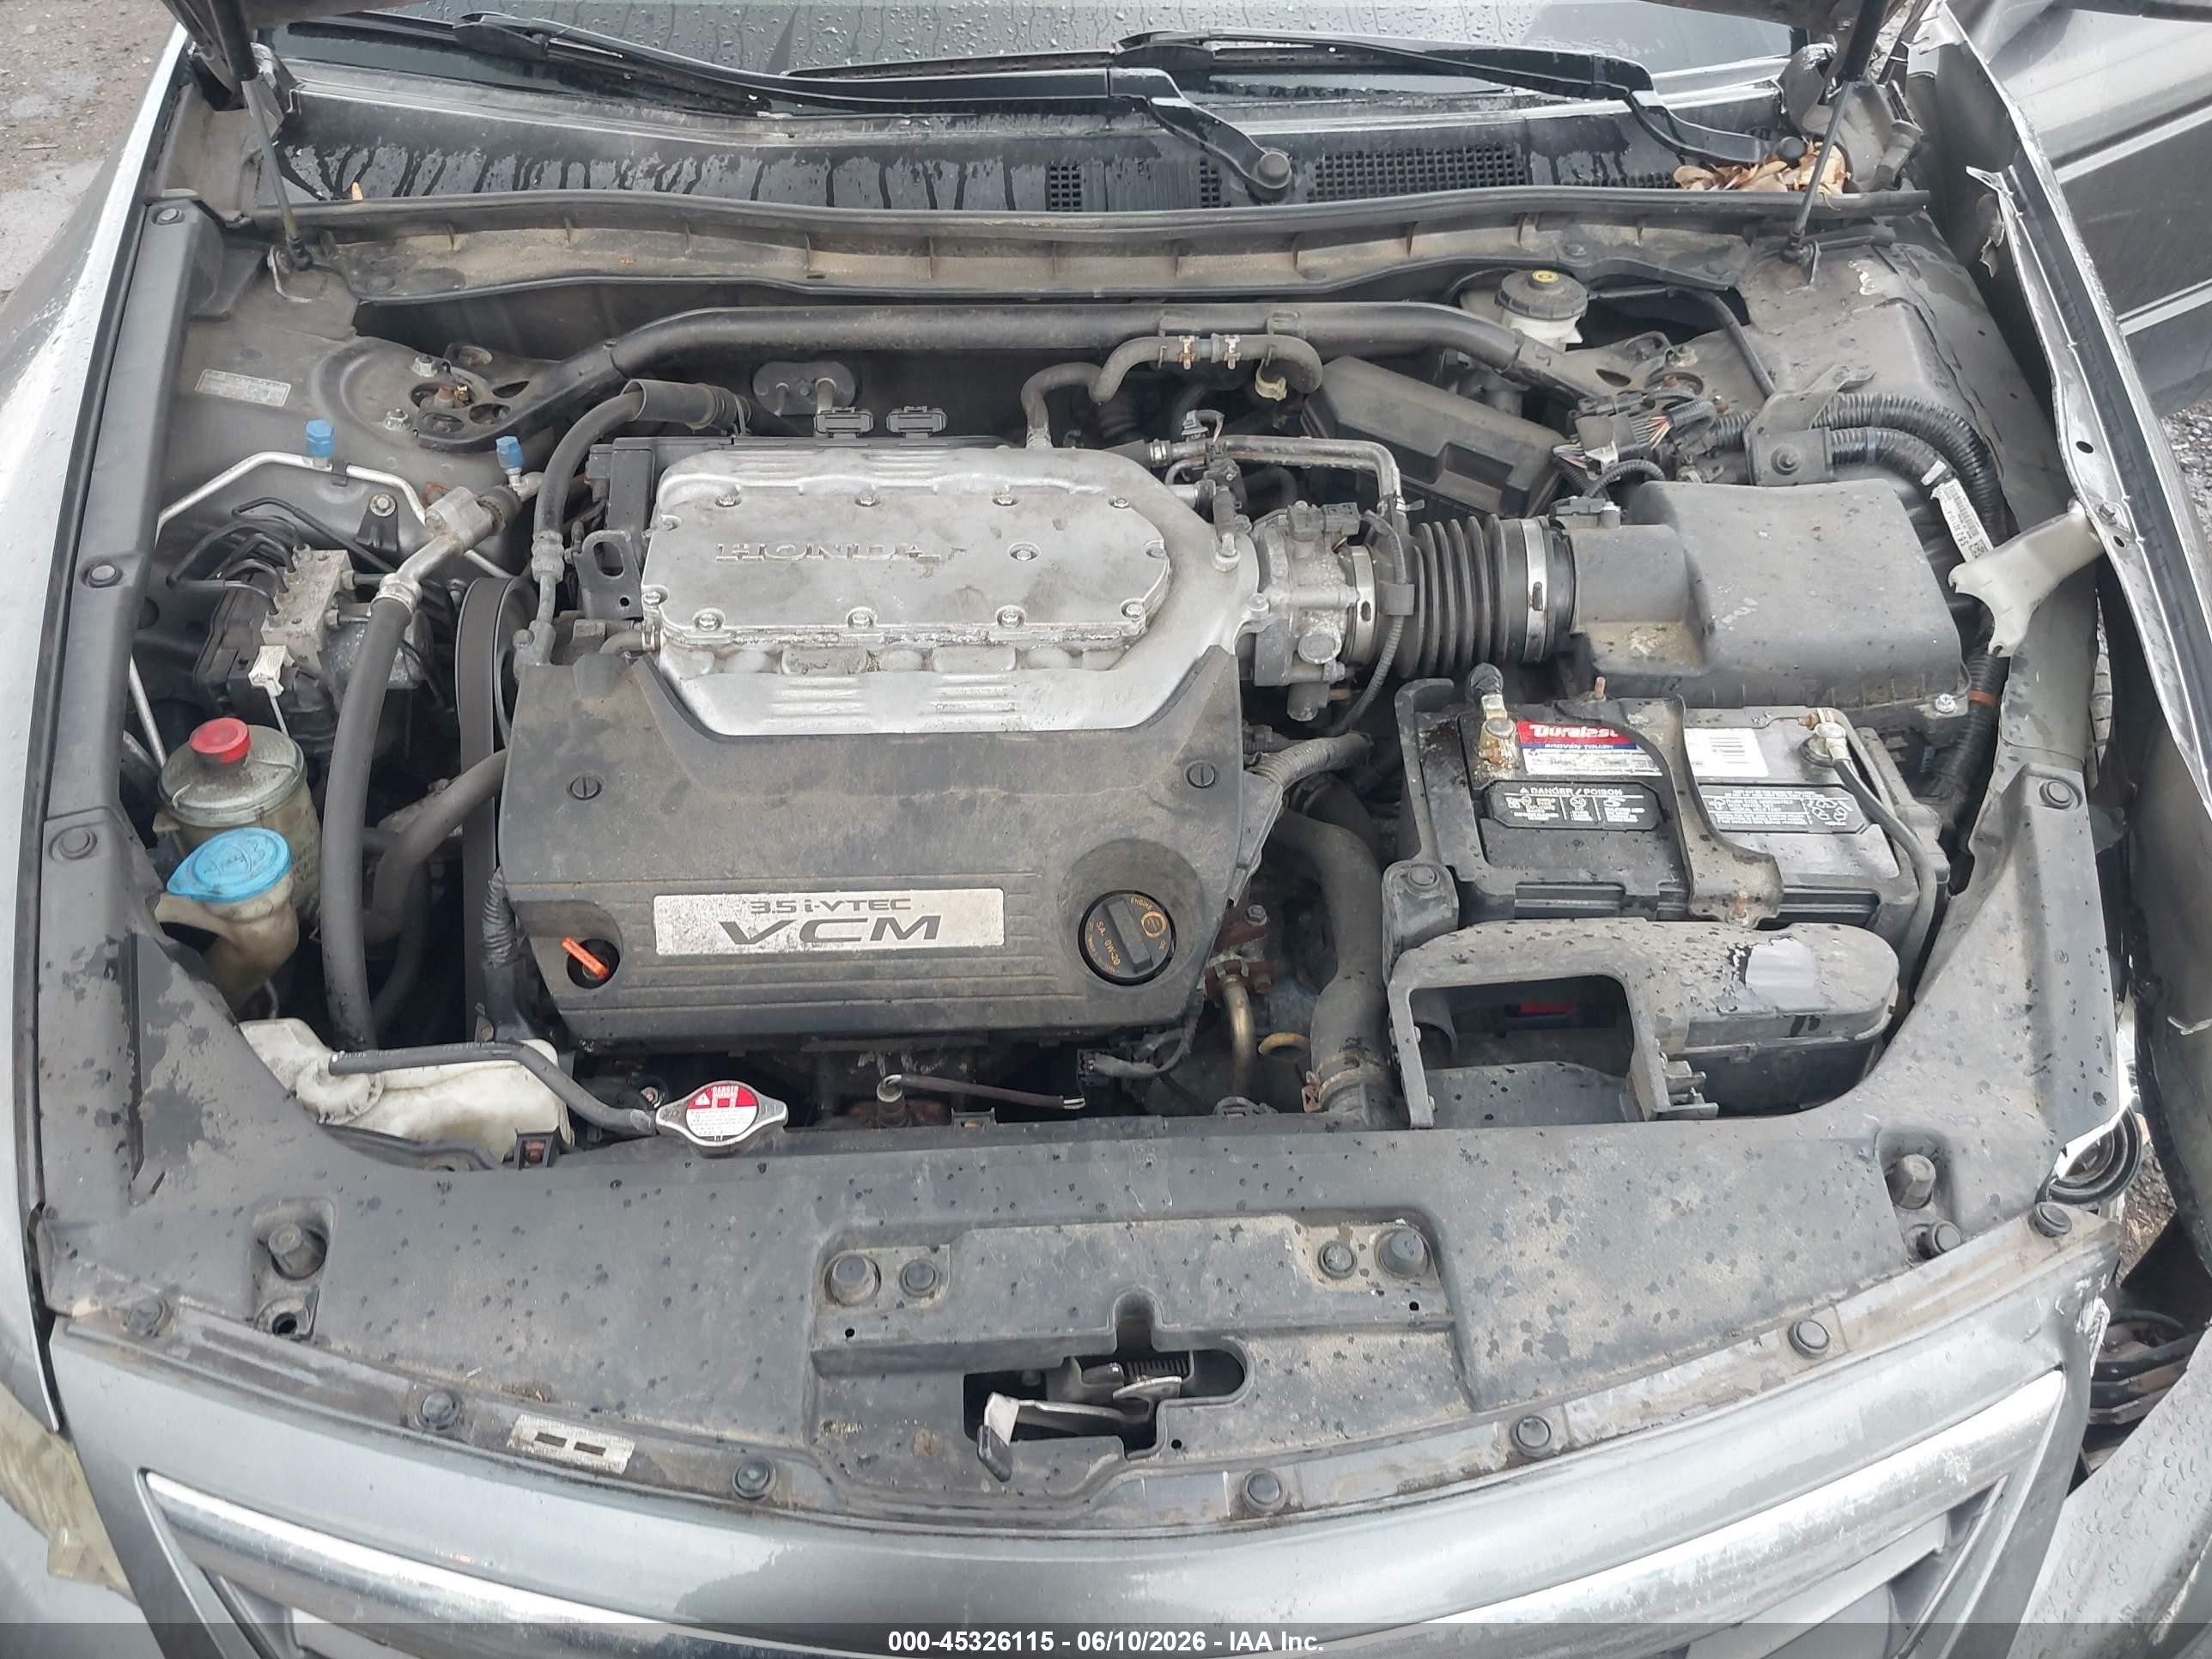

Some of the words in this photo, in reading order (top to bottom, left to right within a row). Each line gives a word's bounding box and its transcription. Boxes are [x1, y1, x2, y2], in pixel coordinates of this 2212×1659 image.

[715, 542, 941, 562] HONDA
[1528, 723, 1620, 738] Duralast
[1530, 787, 1573, 795] DANGER
[1583, 787, 1623, 796] POISON
[750, 900, 798, 915] 3.5
[804, 898, 912, 913] i-VTEC
[1130, 897, 1153, 910] ENGINE
[718, 915, 942, 945] VCM
[1104, 939, 1120, 965] 0W-20
